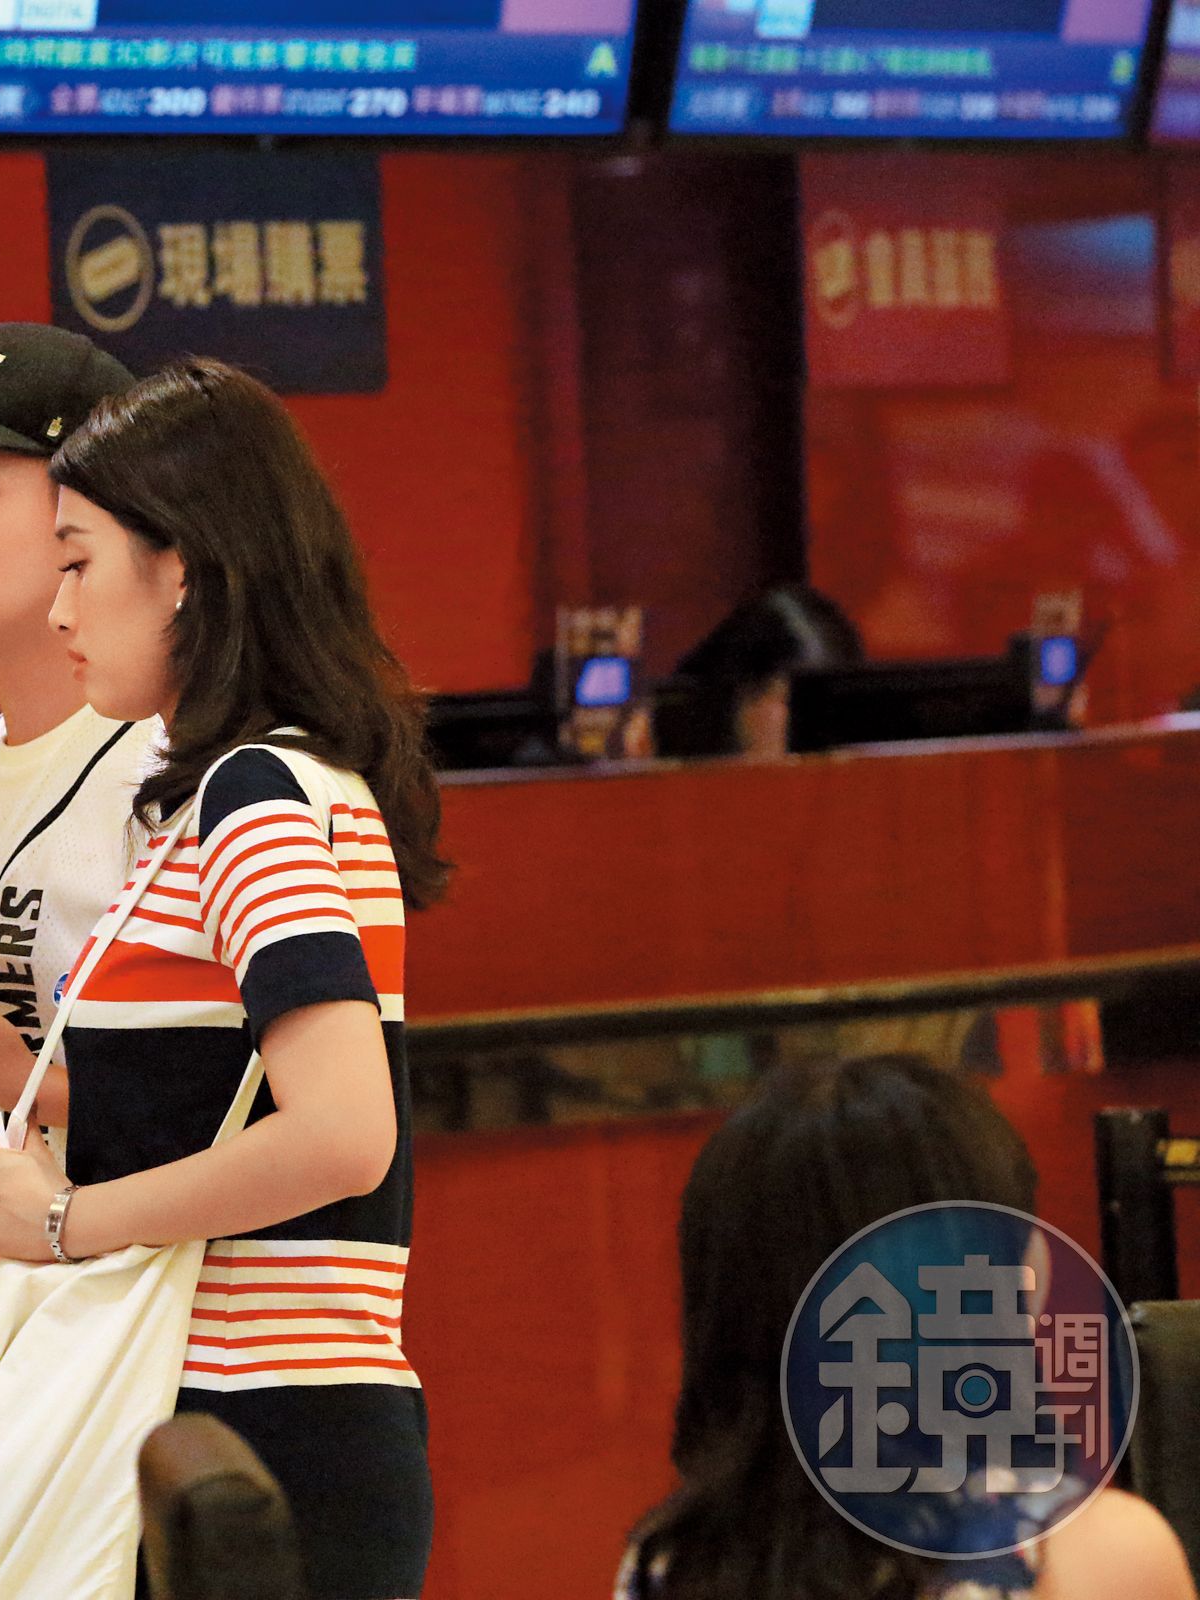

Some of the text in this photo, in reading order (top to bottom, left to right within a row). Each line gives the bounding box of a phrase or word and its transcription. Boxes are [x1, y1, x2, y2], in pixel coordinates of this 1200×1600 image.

[586, 42, 617, 77] A
[347, 87, 409, 118] 270
[157, 219, 367, 309] 現場購票
